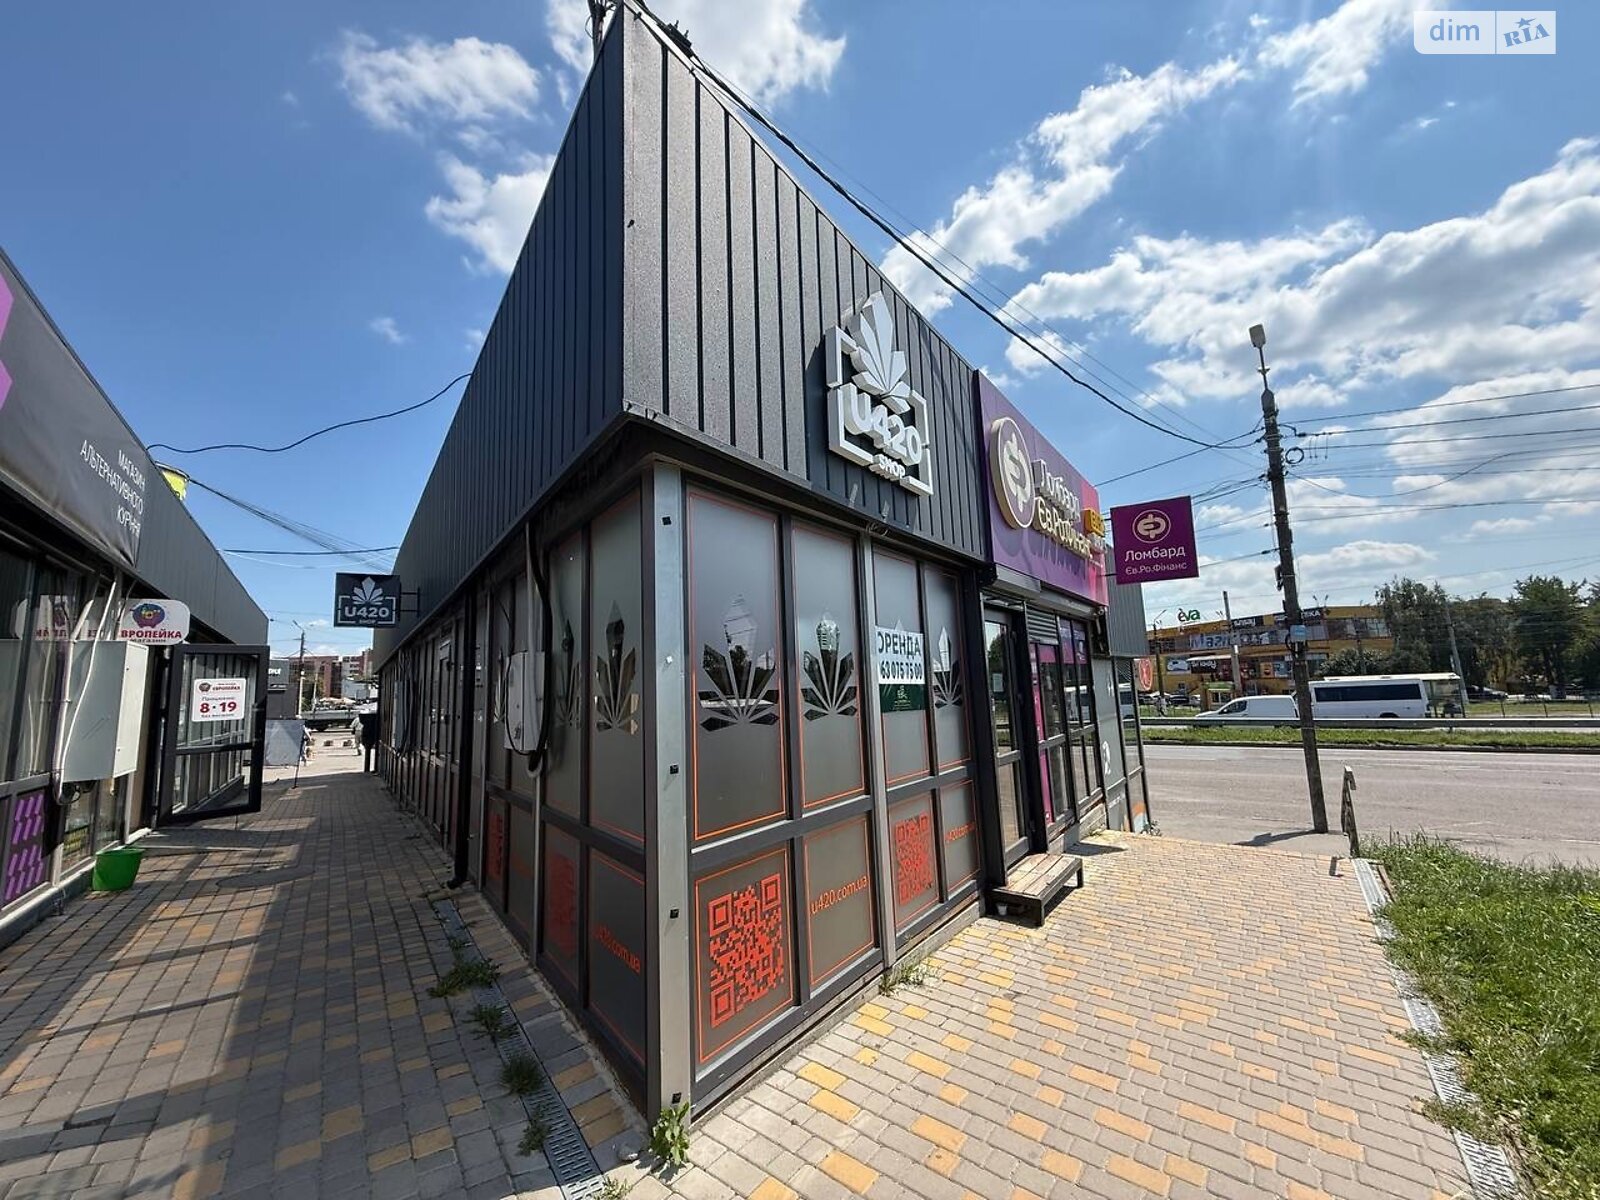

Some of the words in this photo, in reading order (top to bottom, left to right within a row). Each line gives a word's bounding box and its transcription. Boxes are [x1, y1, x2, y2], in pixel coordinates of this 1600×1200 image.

[840, 382, 922, 466] U420
[80, 440, 144, 515] АЛЬТЕРНАТИВНОГО
[118, 449, 146, 492] МАГАЗИН
[870, 452, 906, 479] SHOP
[1124, 546, 1186, 562] Ломбард
[344, 606, 390, 618] U420
[121, 628, 182, 639] ВРОПЕЙКА
[810, 875, 868, 914] u420.com.ua
